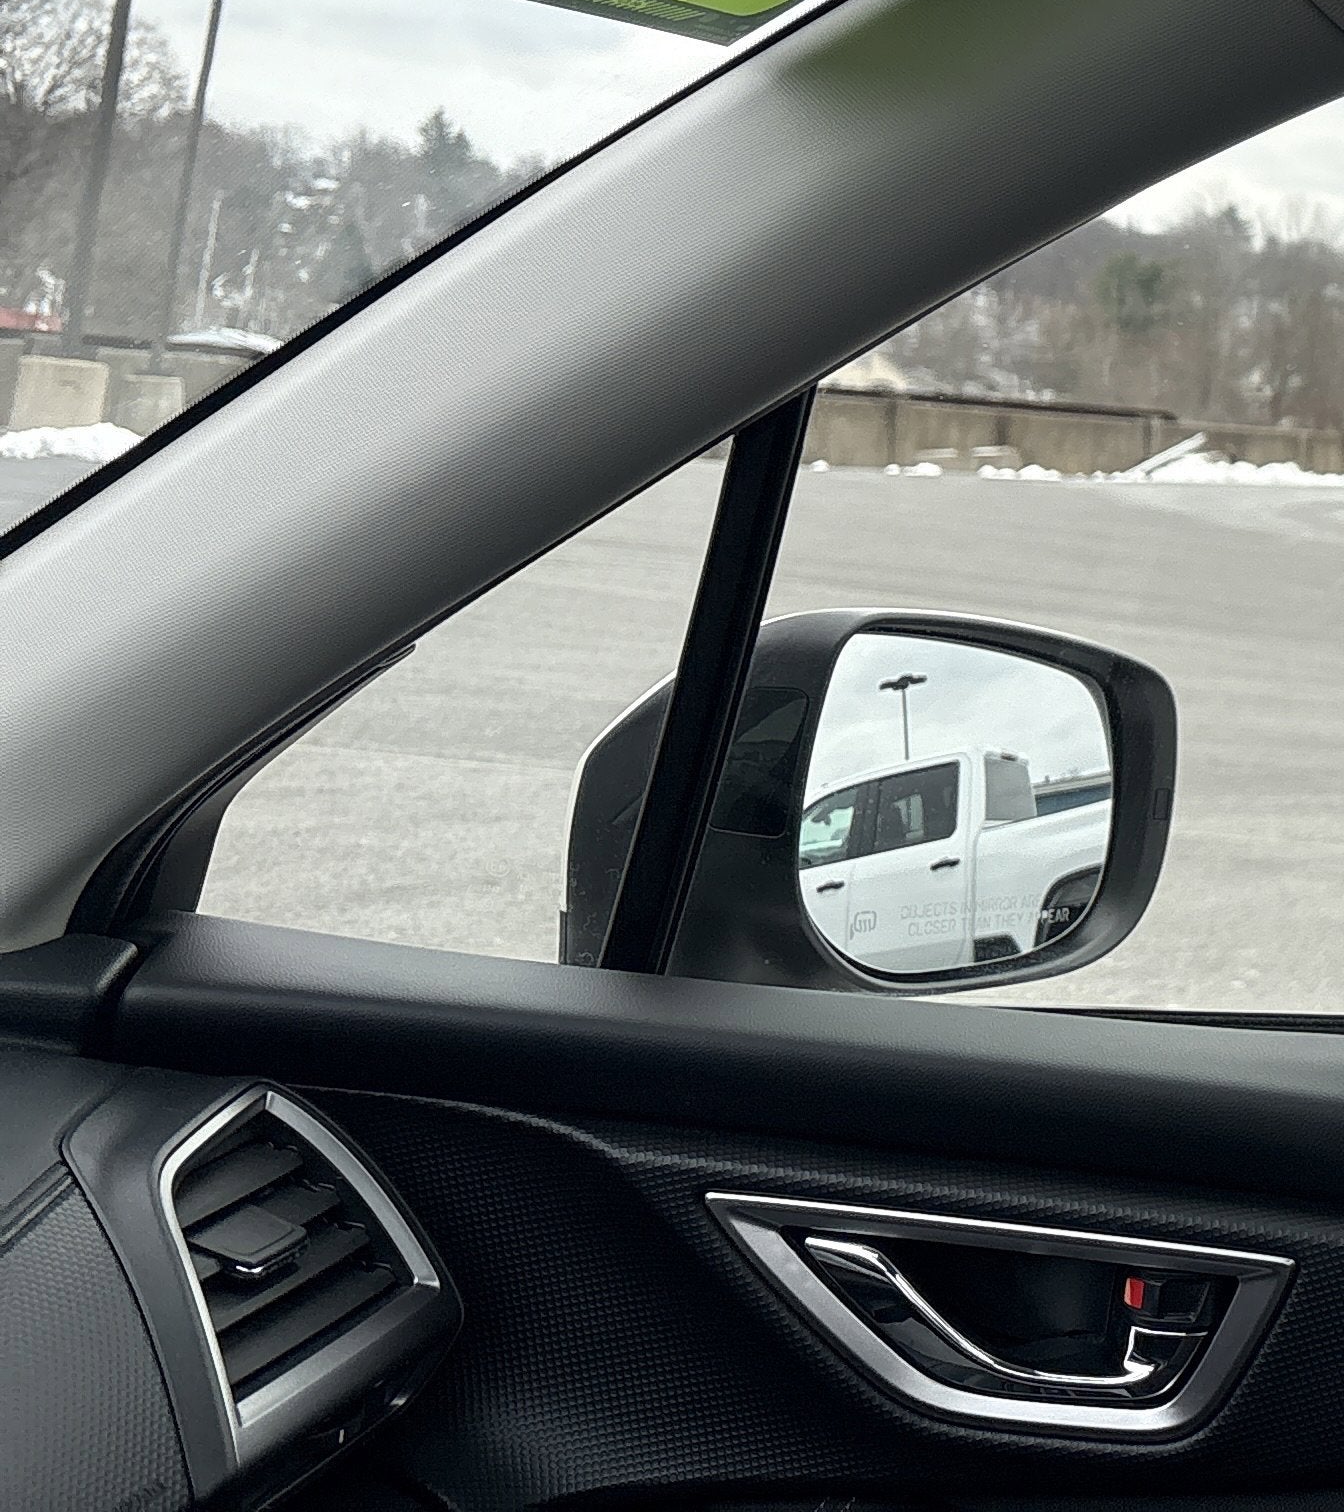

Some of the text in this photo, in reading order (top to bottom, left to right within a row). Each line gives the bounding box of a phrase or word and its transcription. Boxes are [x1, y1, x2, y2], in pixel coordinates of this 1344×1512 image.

[900, 901, 958, 919] OBJECTS
[960, 900, 973, 915] IN
[976, 896, 1017, 913] MIRROR
[908, 918, 957, 936] CLOSER
[994, 911, 1023, 928] THEY
